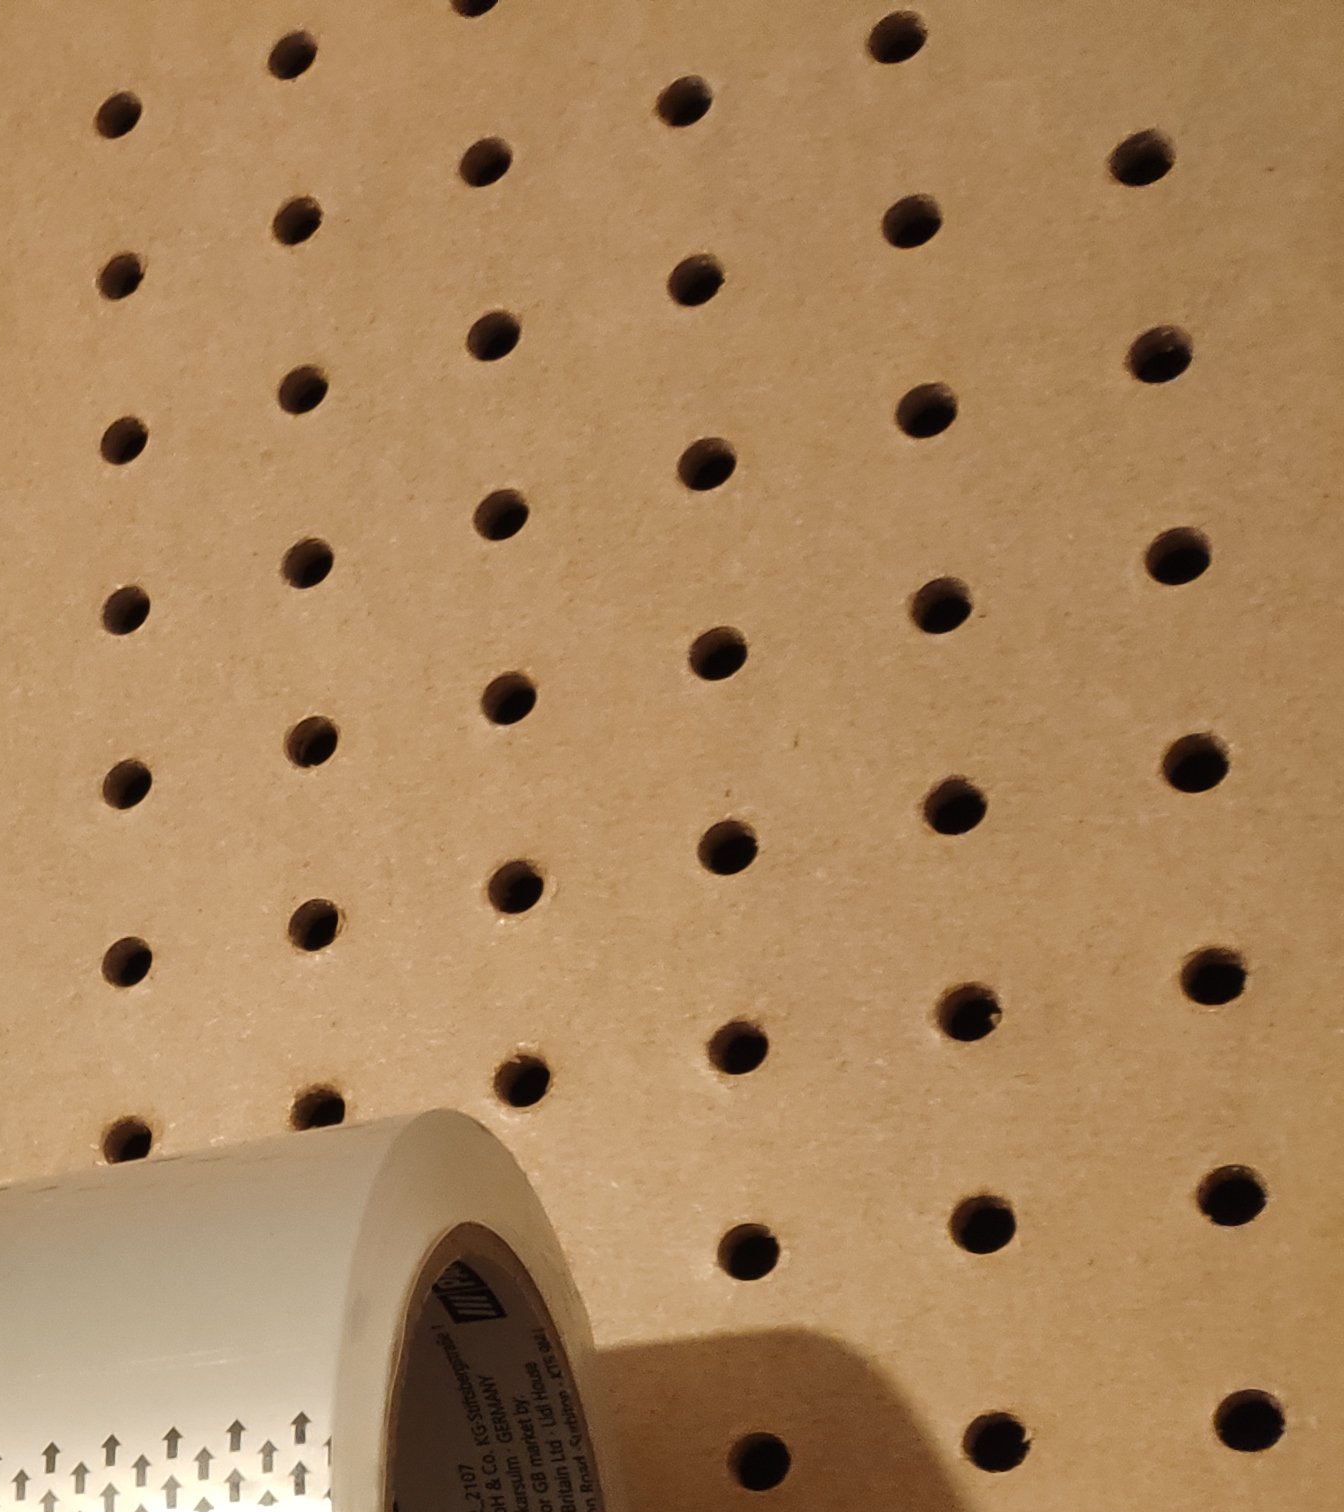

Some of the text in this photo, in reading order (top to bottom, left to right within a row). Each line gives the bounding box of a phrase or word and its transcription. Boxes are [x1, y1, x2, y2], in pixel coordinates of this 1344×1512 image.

[524, 1362, 549, 1400] House
[478, 1374, 513, 1443] GERMANY
[534, 1403, 557, 1428] Lidl
[518, 1418, 543, 1467] market
[548, 1439, 565, 1463] Ltd
[481, 1451, 498, 1475] Co.
[485, 1478, 502, 1491] &
[530, 1472, 548, 1494] GB
